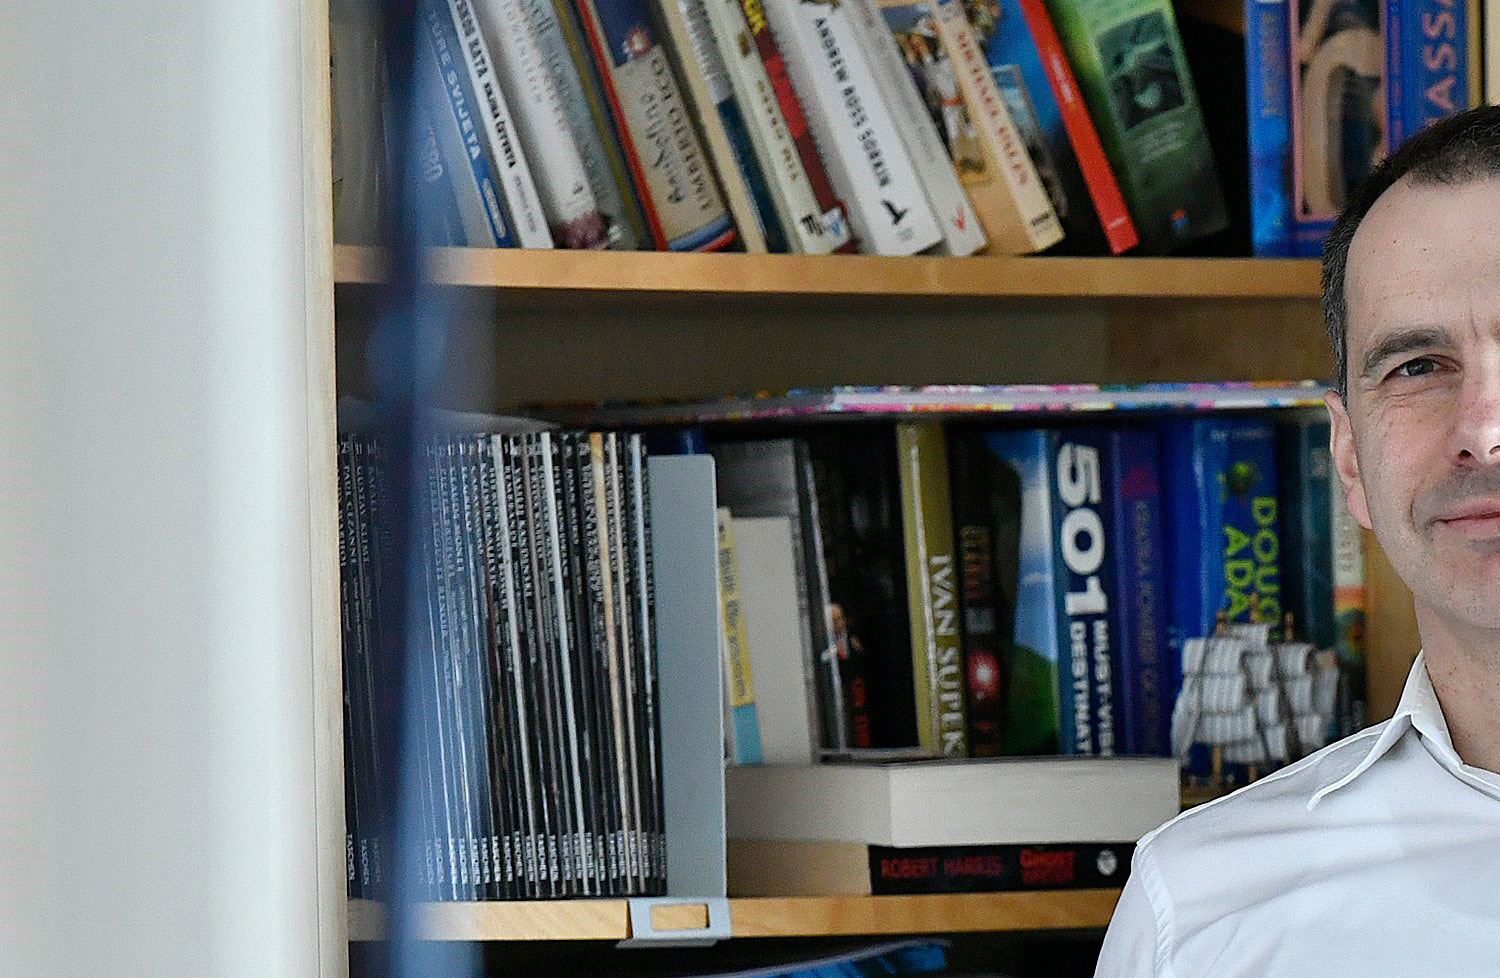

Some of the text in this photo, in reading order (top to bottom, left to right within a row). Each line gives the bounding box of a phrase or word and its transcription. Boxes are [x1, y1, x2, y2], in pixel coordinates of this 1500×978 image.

[440, 68, 486, 161] SVIJETA
[809, 14, 896, 189] ANDREW ROSS SORKIN
[663, 104, 718, 213] UMBERTO
[359, 521, 371, 564] KLIMT
[1053, 439, 1109, 617] 501
[925, 551, 960, 638] IVAN
[880, 857, 937, 879] ROBERT
